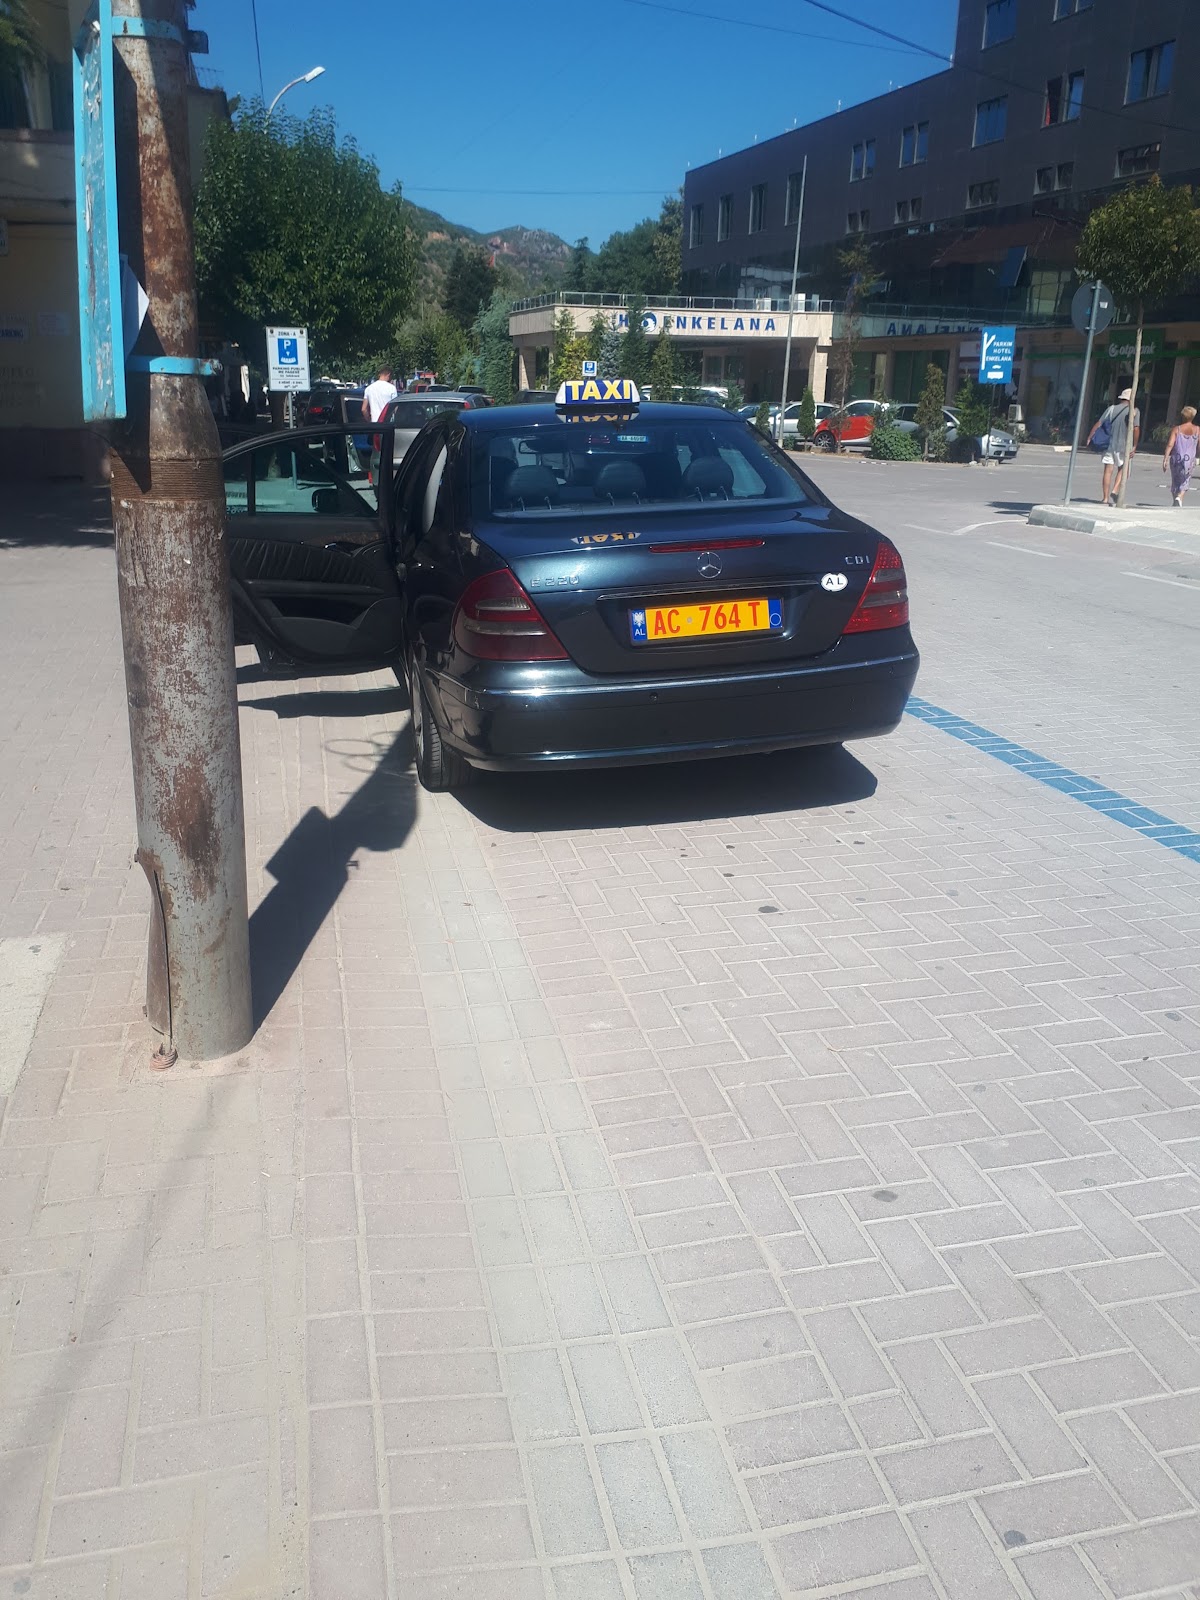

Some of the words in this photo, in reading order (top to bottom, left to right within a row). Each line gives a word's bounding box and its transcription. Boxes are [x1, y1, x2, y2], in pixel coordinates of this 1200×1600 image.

[284, 340, 291, 350] P
[566, 380, 632, 401] TAXI
[845, 555, 870, 565] CDI
[545, 575, 579, 587] 220
[826, 577, 844, 586] AL
[654, 608, 681, 636] AC
[699, 603, 741, 632] 764
[748, 601, 760, 627] T
[634, 628, 646, 636] AL
